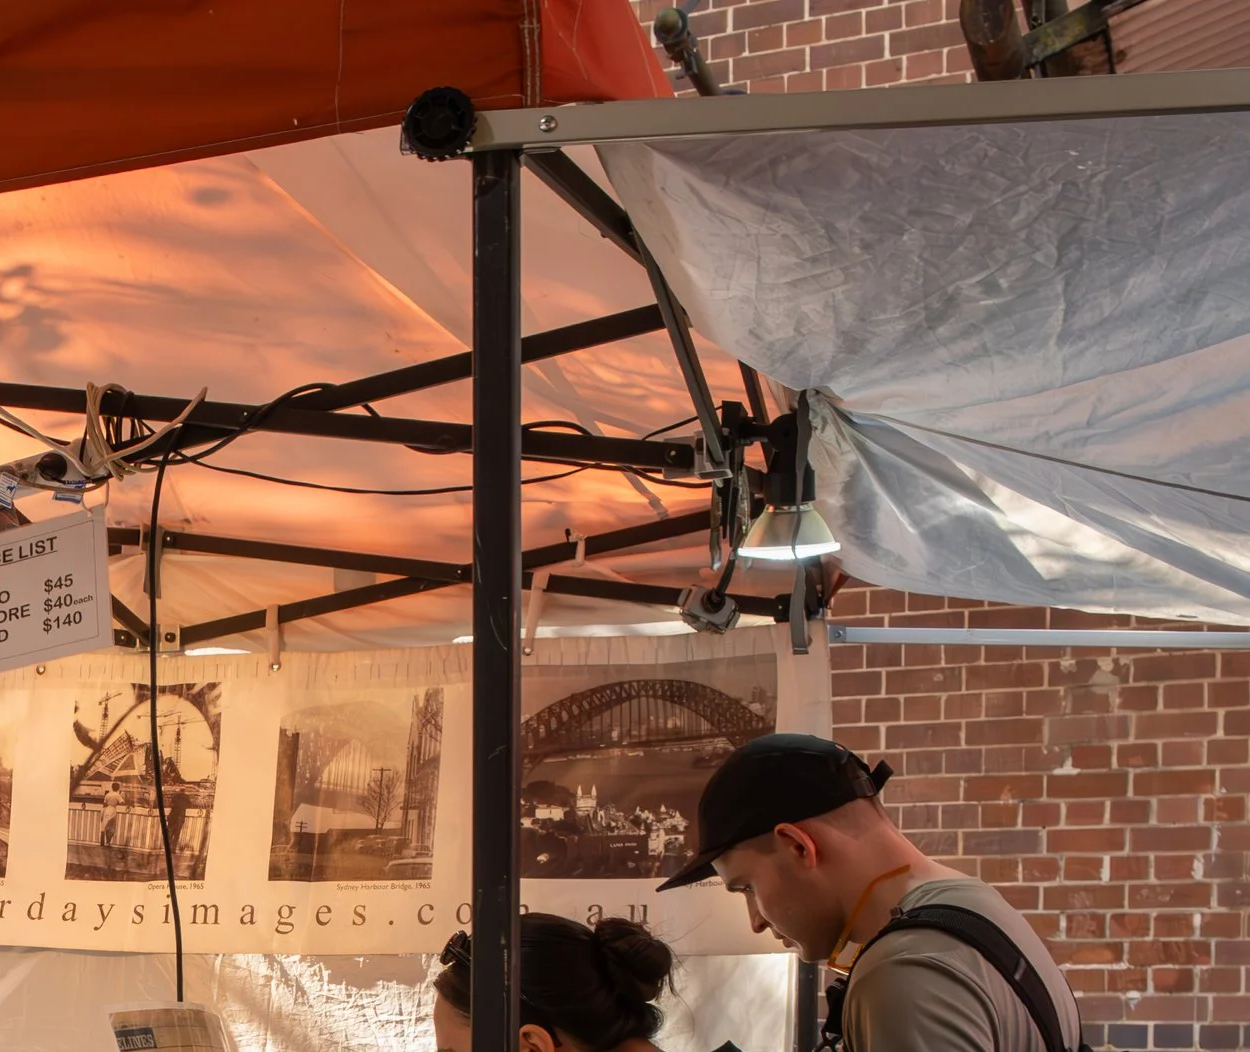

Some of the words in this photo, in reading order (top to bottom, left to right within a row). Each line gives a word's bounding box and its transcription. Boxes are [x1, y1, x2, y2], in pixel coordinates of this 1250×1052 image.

[18, 536, 58, 557] LIST
[44, 574, 74, 594] $45
[42, 611, 82, 634] $140
